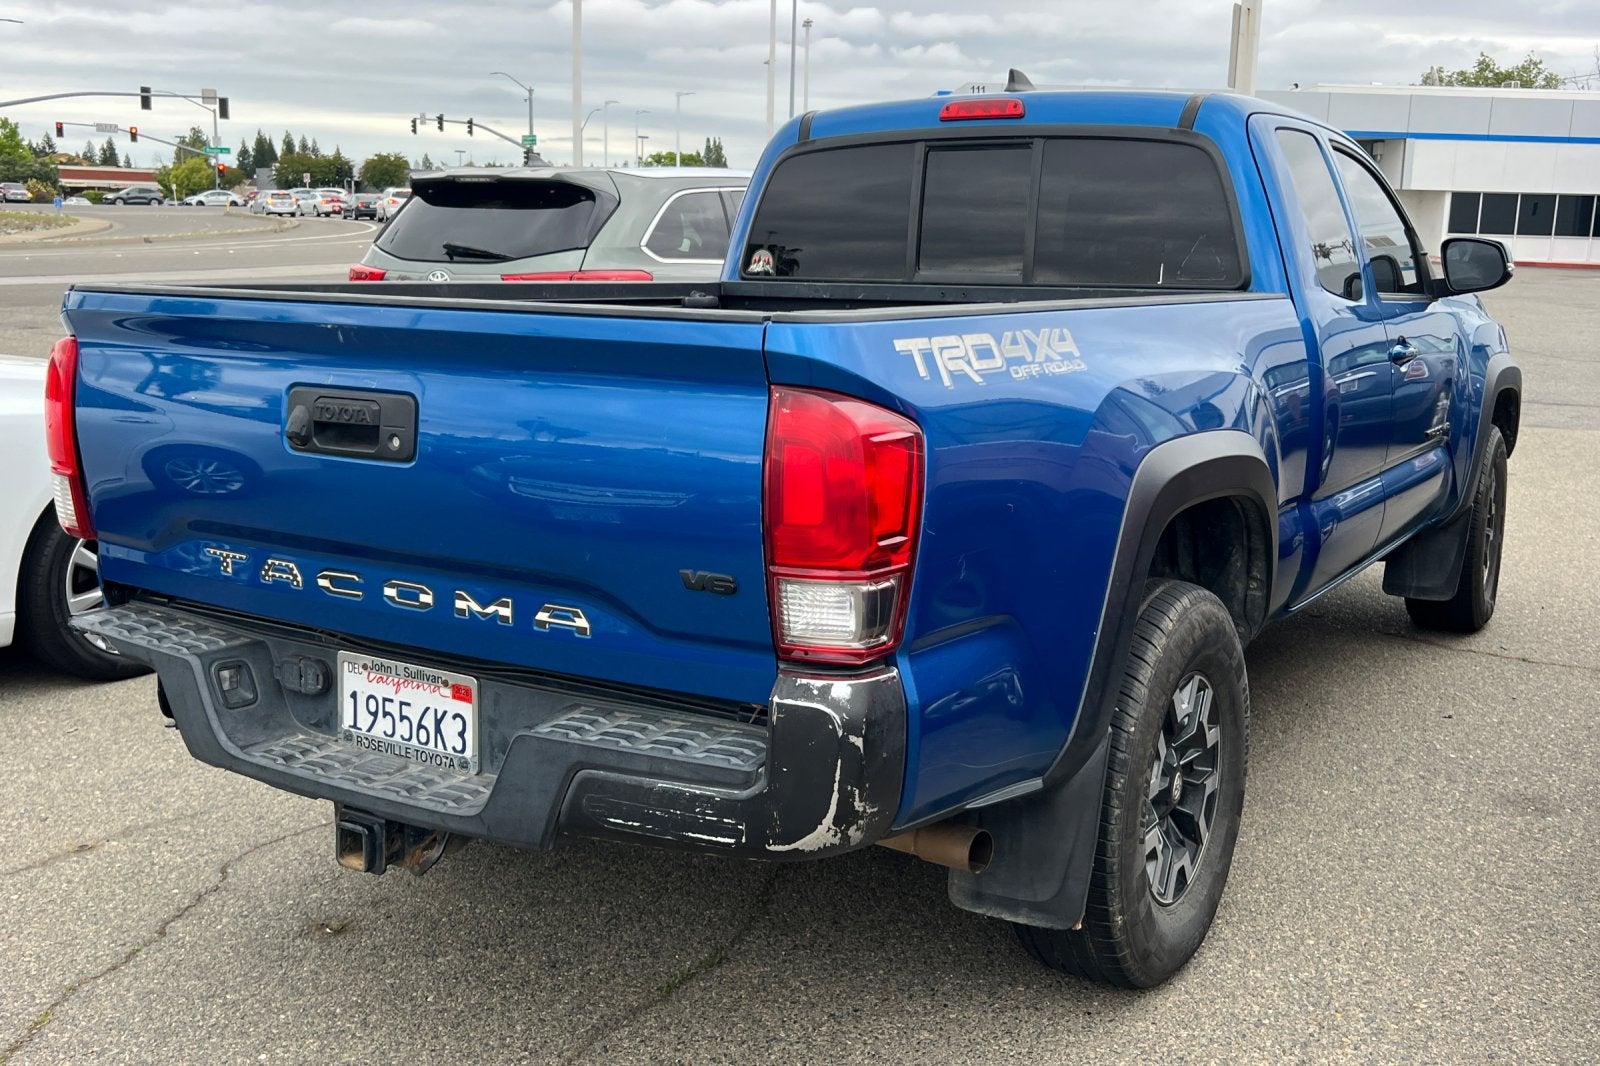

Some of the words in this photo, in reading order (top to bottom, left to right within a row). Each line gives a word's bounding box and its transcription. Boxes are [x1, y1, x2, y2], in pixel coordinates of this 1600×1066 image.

[893, 333, 1004, 388] TRD
[1010, 364, 1042, 379] OFF
[1044, 359, 1087, 374] ROAD
[316, 403, 371, 423] TOYOTA
[205, 547, 593, 638] TACOMA
[679, 569, 737, 595] V6
[369, 659, 392, 674] John
[395, 665, 401, 676] L
[403, 667, 443, 685] Sullivan
[349, 690, 467, 755] 19556K3
[356, 735, 411, 759] ROSEVILLE
[414, 748, 456, 769] TOYOTA
